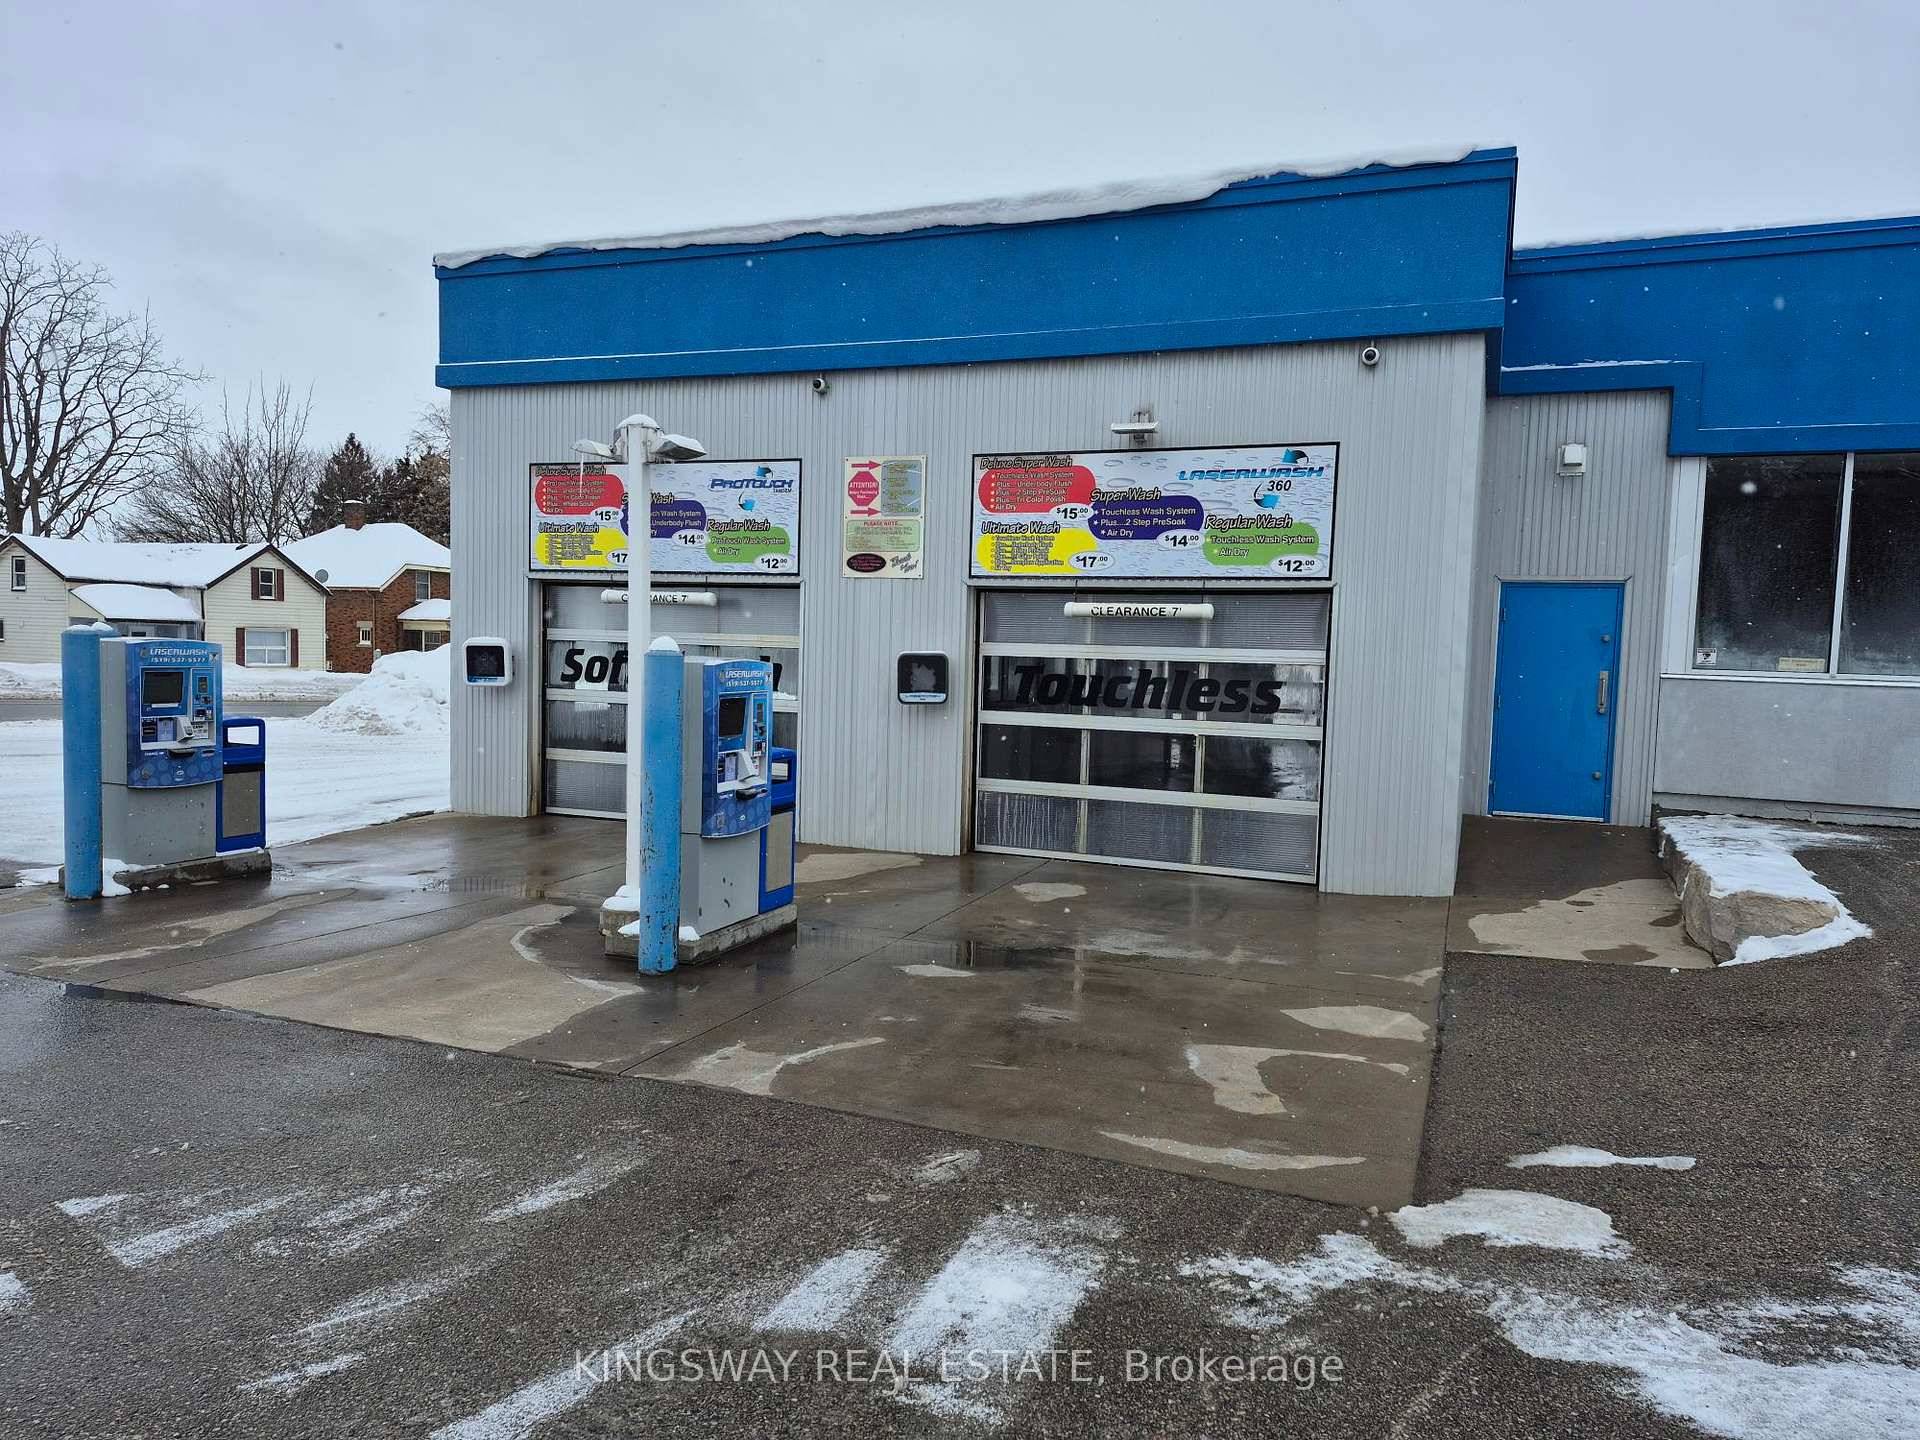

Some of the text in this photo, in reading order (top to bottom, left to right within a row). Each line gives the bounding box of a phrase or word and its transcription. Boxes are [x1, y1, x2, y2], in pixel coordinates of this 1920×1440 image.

[1045, 455, 1073, 467] Wash
[1177, 466, 1324, 480] LASERWASH
[1267, 480, 1292, 491] 360
[1090, 487, 1161, 505] Super Wash
[1057, 508, 1088, 519] $15.00
[1102, 508, 1140, 516] Touchless
[1166, 507, 1196, 516] System
[576, 522, 599, 533] Wash
[707, 518, 770, 534] Regular Wash
[981, 521, 1061, 534] Ultimate Wash
[1133, 519, 1150, 527] Step
[1153, 518, 1186, 526] PreSoak
[1205, 513, 1292, 532] Regular Wash
[1120, 529, 1133, 537] Dry
[761, 537, 784, 545] System
[1165, 535, 1199, 547] $14.00
[1211, 535, 1314, 545] Touchless Wash System
[1218, 549, 1249, 558] Air Dry
[761, 558, 787, 569] $12.00
[1076, 556, 1108, 567] $17.00
[1278, 560, 1314, 572] $12.00
[1091, 606, 1167, 617] CLEARANCE
[560, 648, 629, 684] Sof
[1015, 665, 1285, 714] Touchless
